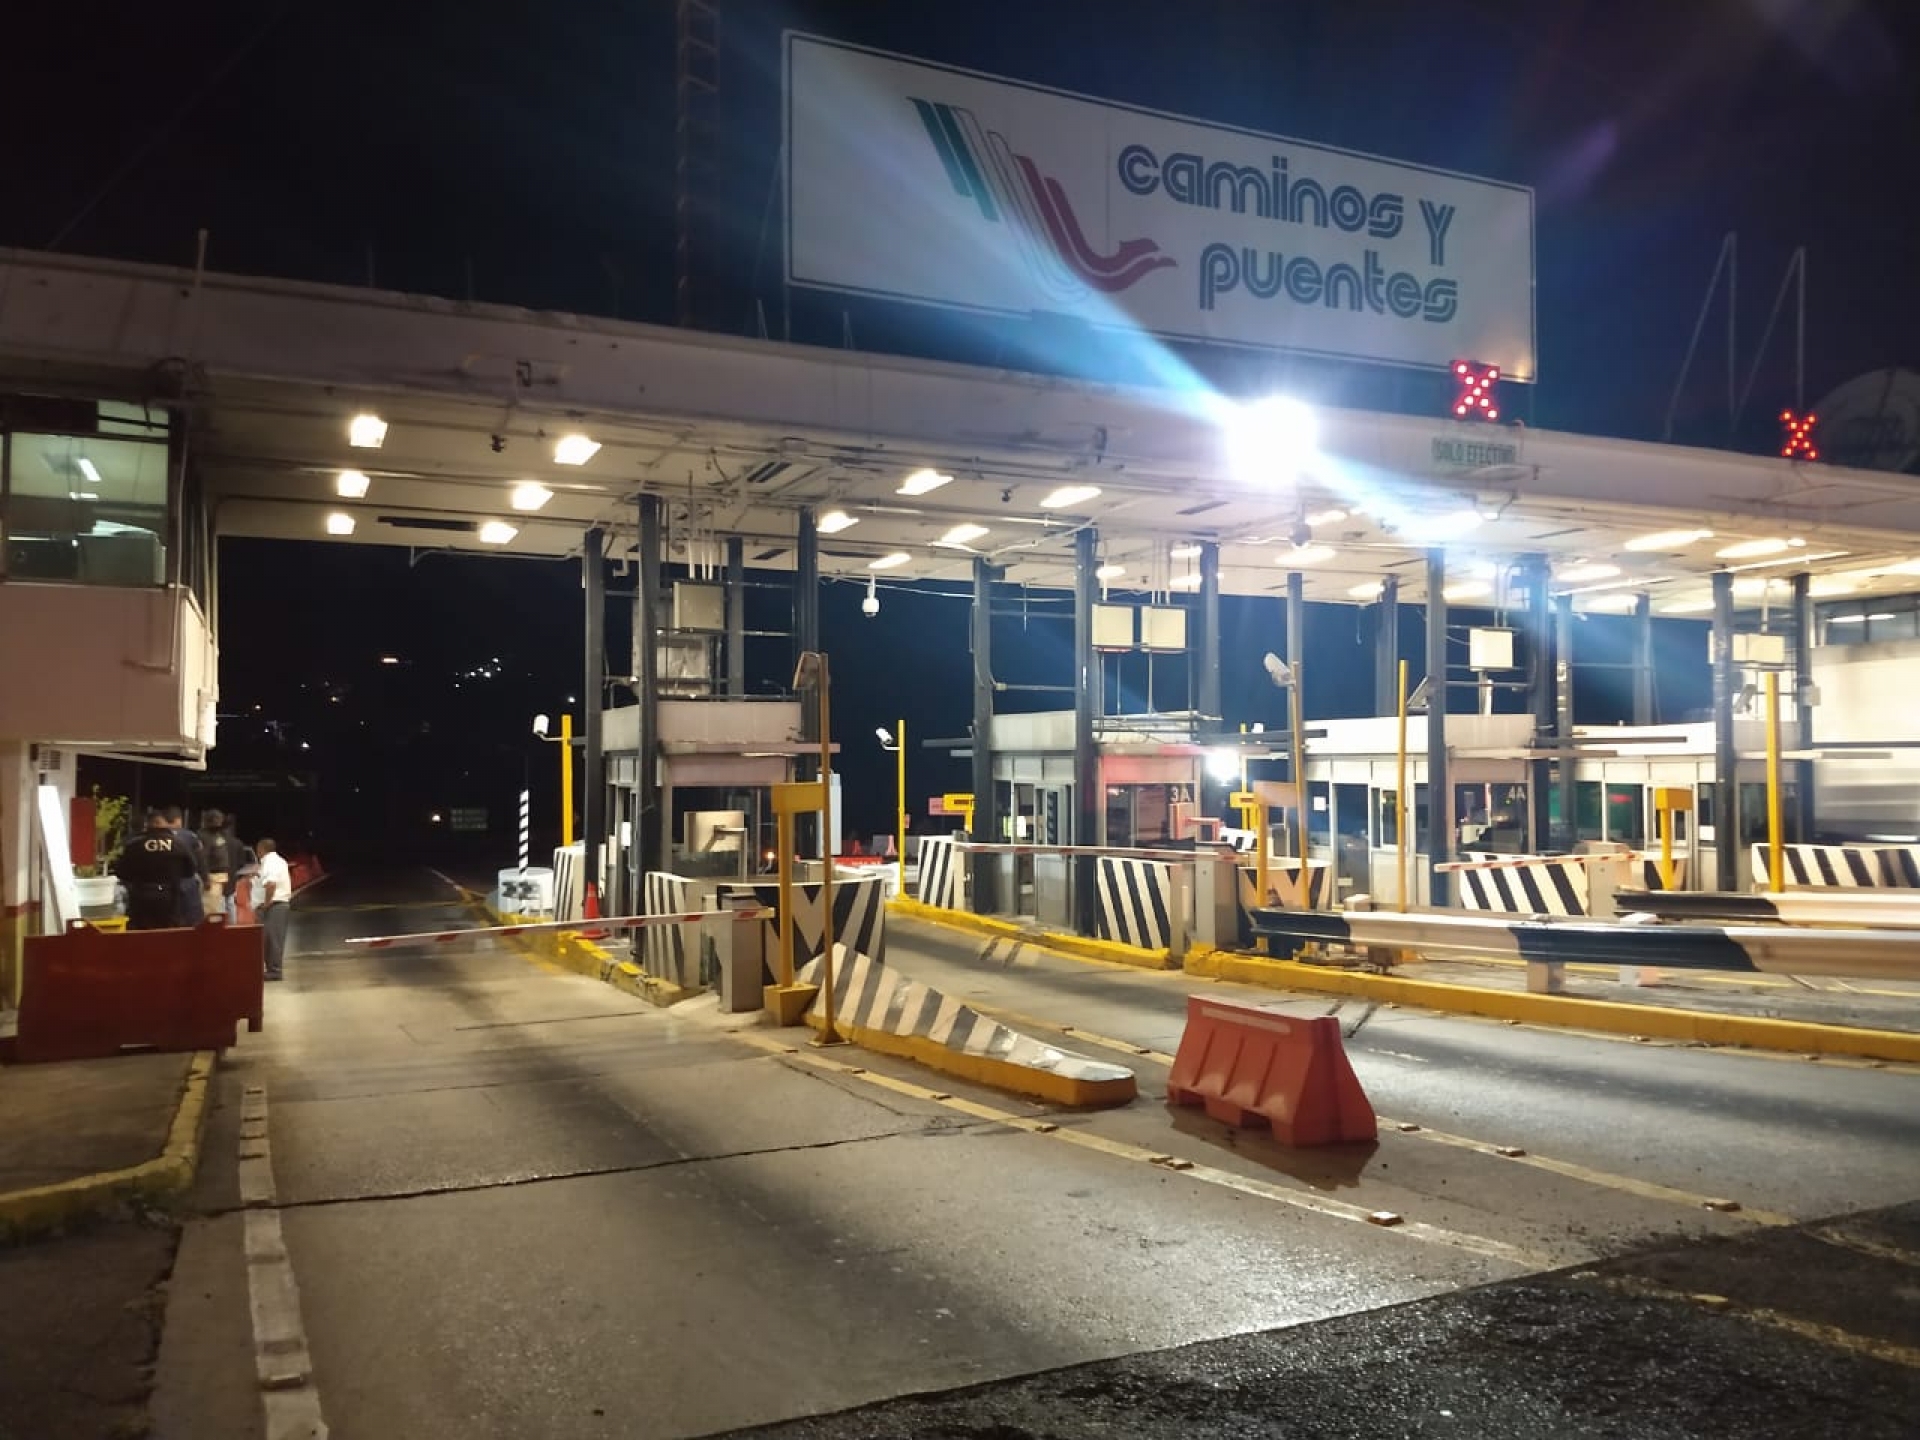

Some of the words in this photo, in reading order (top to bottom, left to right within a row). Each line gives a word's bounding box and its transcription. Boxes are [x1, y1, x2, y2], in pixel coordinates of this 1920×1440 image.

[1118, 144, 1404, 238] caminos
[1418, 199, 1456, 266] Y
[1200, 243, 1459, 323] puentes
[144, 839, 172, 852] GN
